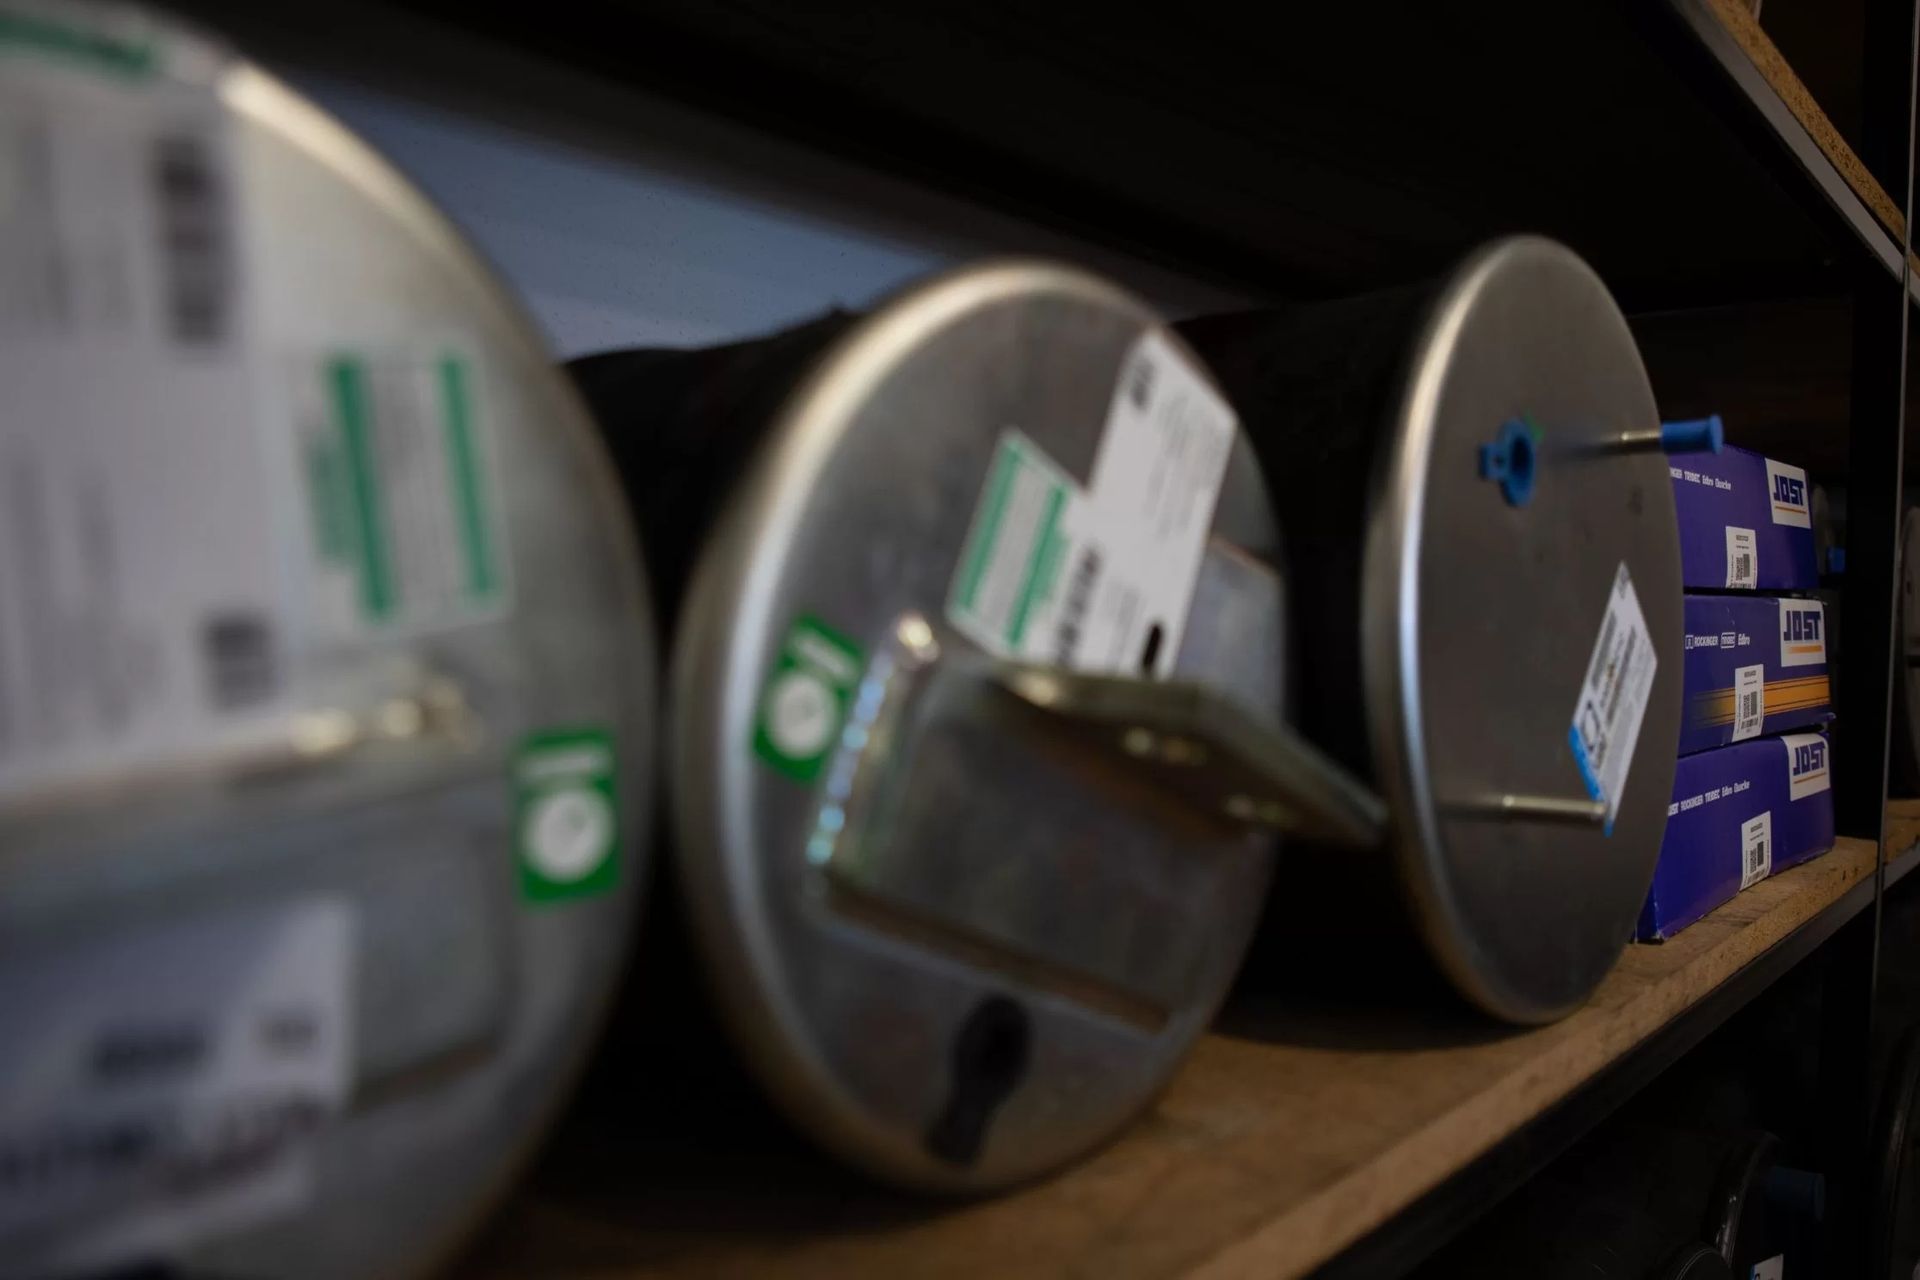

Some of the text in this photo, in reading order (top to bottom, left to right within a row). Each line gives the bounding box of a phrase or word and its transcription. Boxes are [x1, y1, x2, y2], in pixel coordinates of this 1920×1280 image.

[1773, 474, 1804, 506] JOST
[1694, 635, 1719, 647] ROCKINGER
[1783, 610, 1821, 641] JOST
[1793, 741, 1826, 776] JOST
